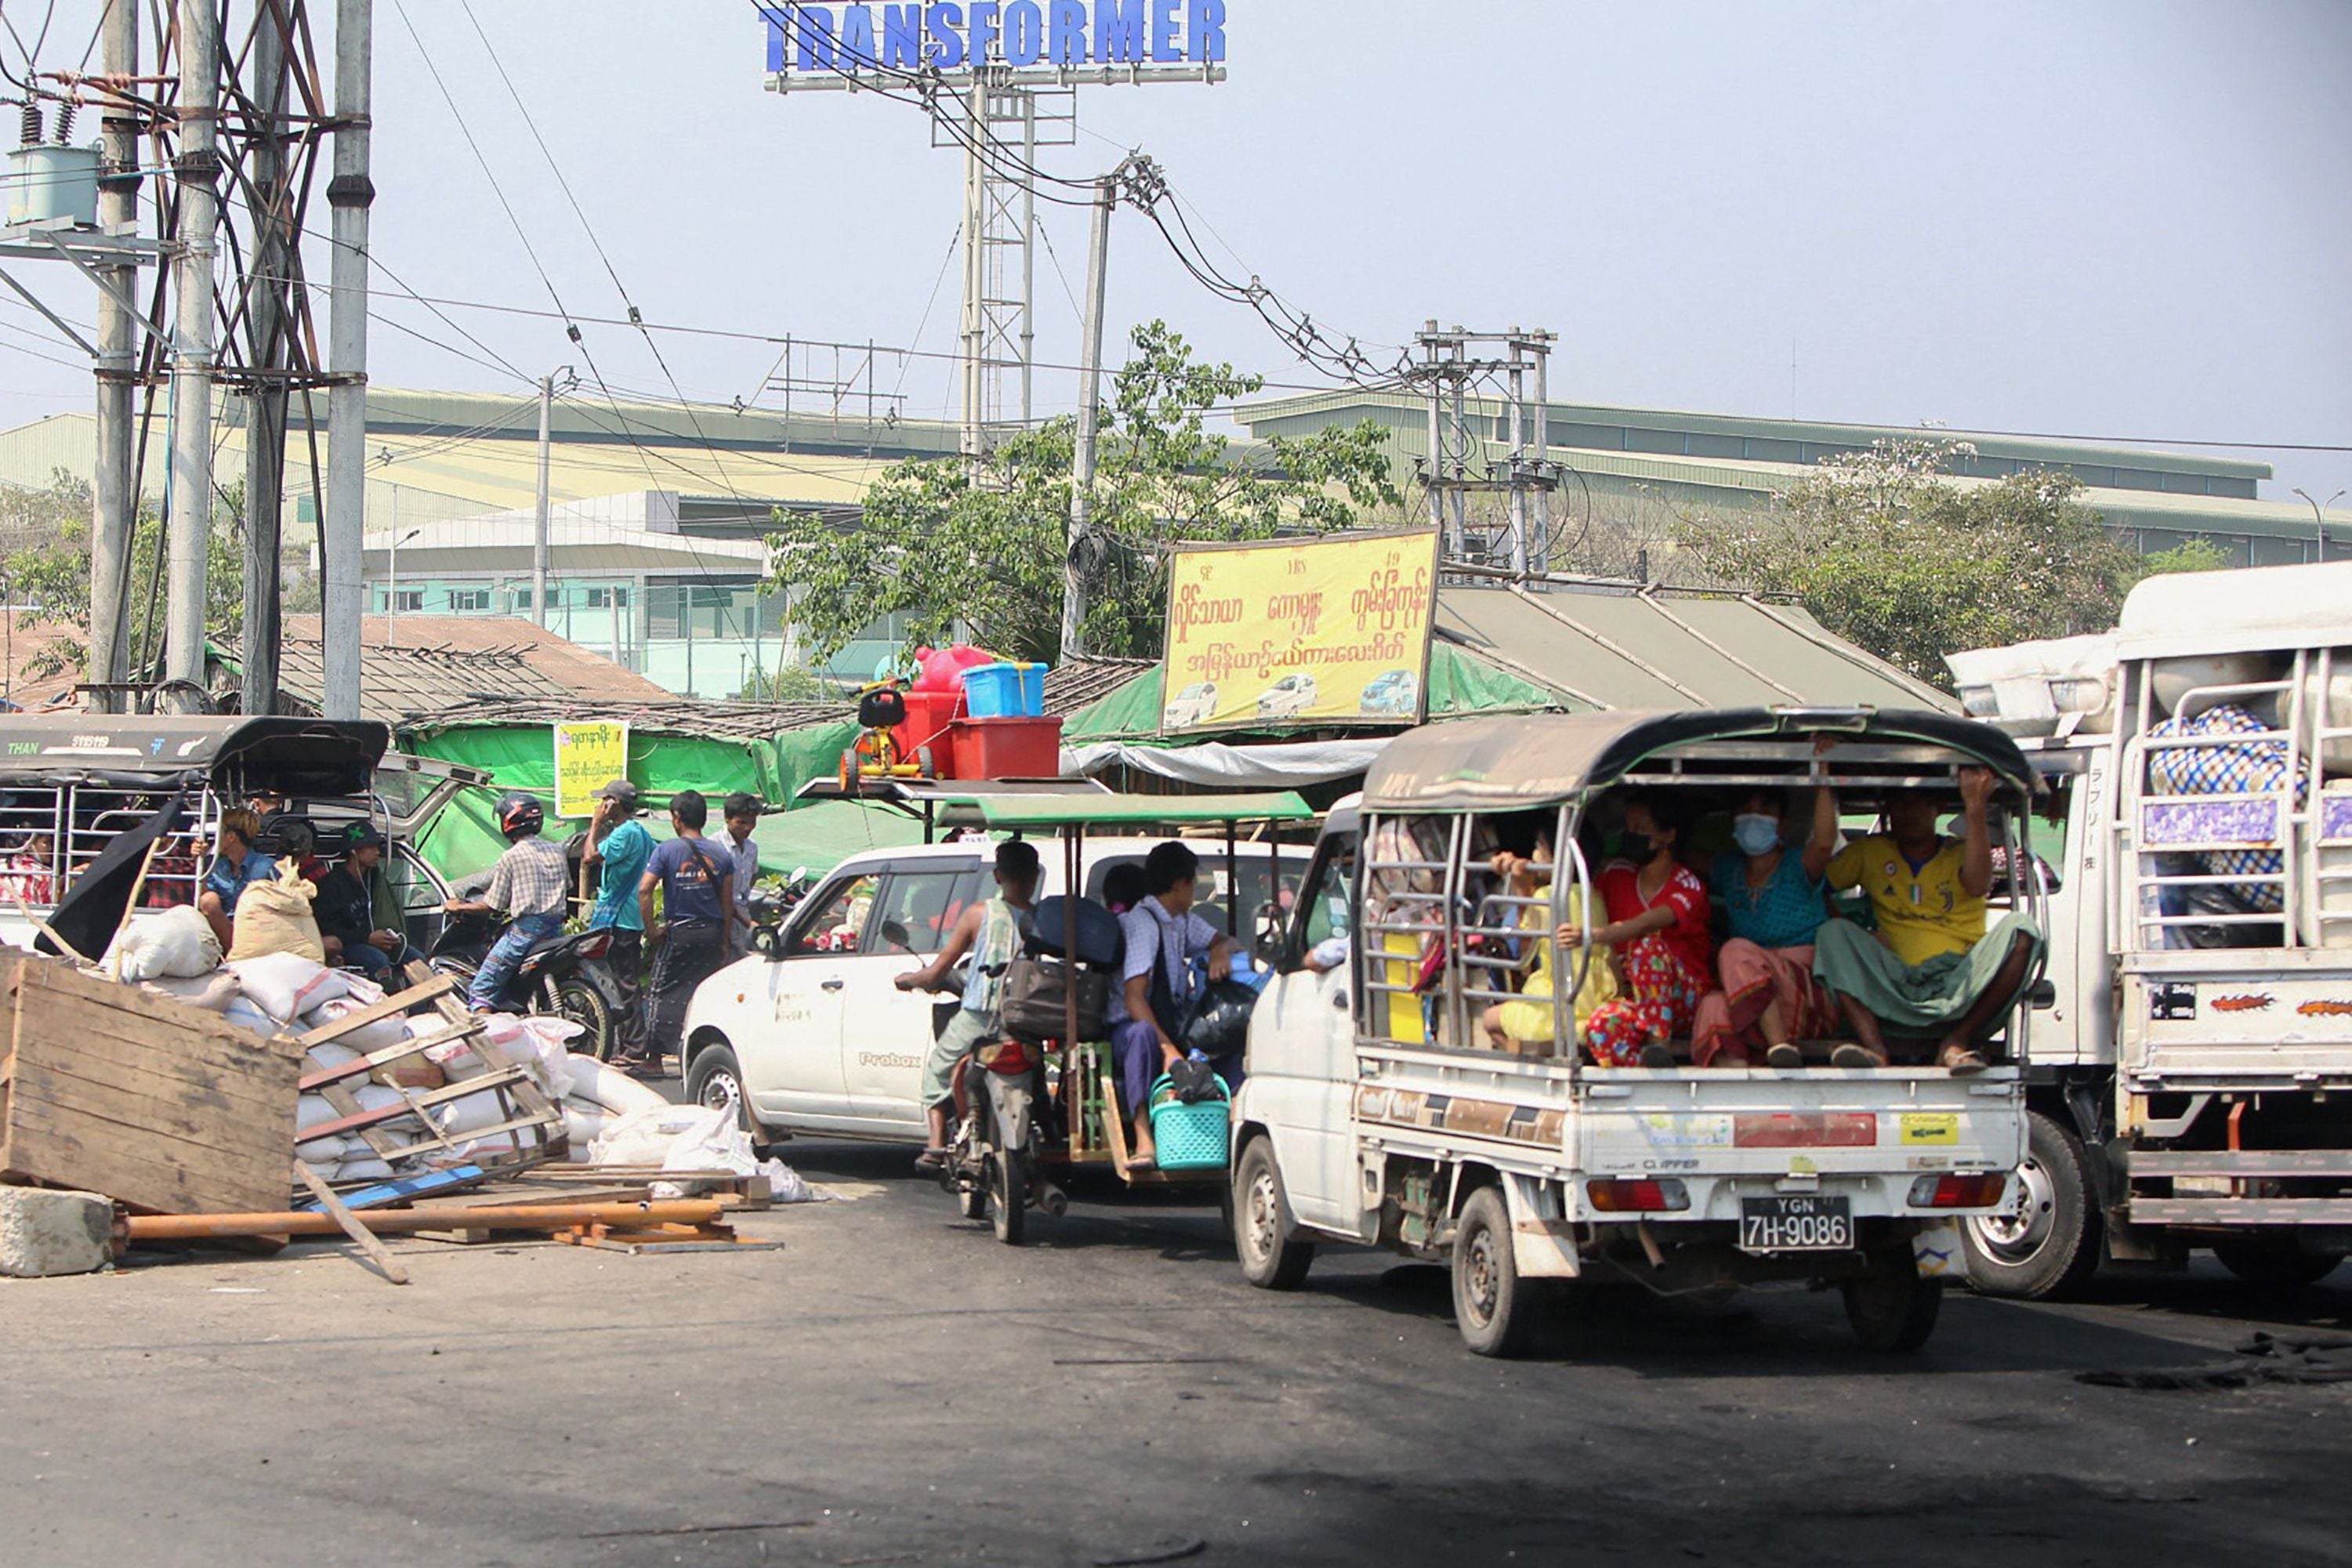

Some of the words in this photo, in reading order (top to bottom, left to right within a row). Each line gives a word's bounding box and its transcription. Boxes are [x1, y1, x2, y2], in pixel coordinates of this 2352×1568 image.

[759, 0, 1227, 72] TRANSFORMER
[8, 742, 38, 755] THAN
[859, 1051, 922, 1068] Probox
[1777, 1198, 1815, 1213] YGN
[1747, 1215, 1847, 1245] 7H-9086
